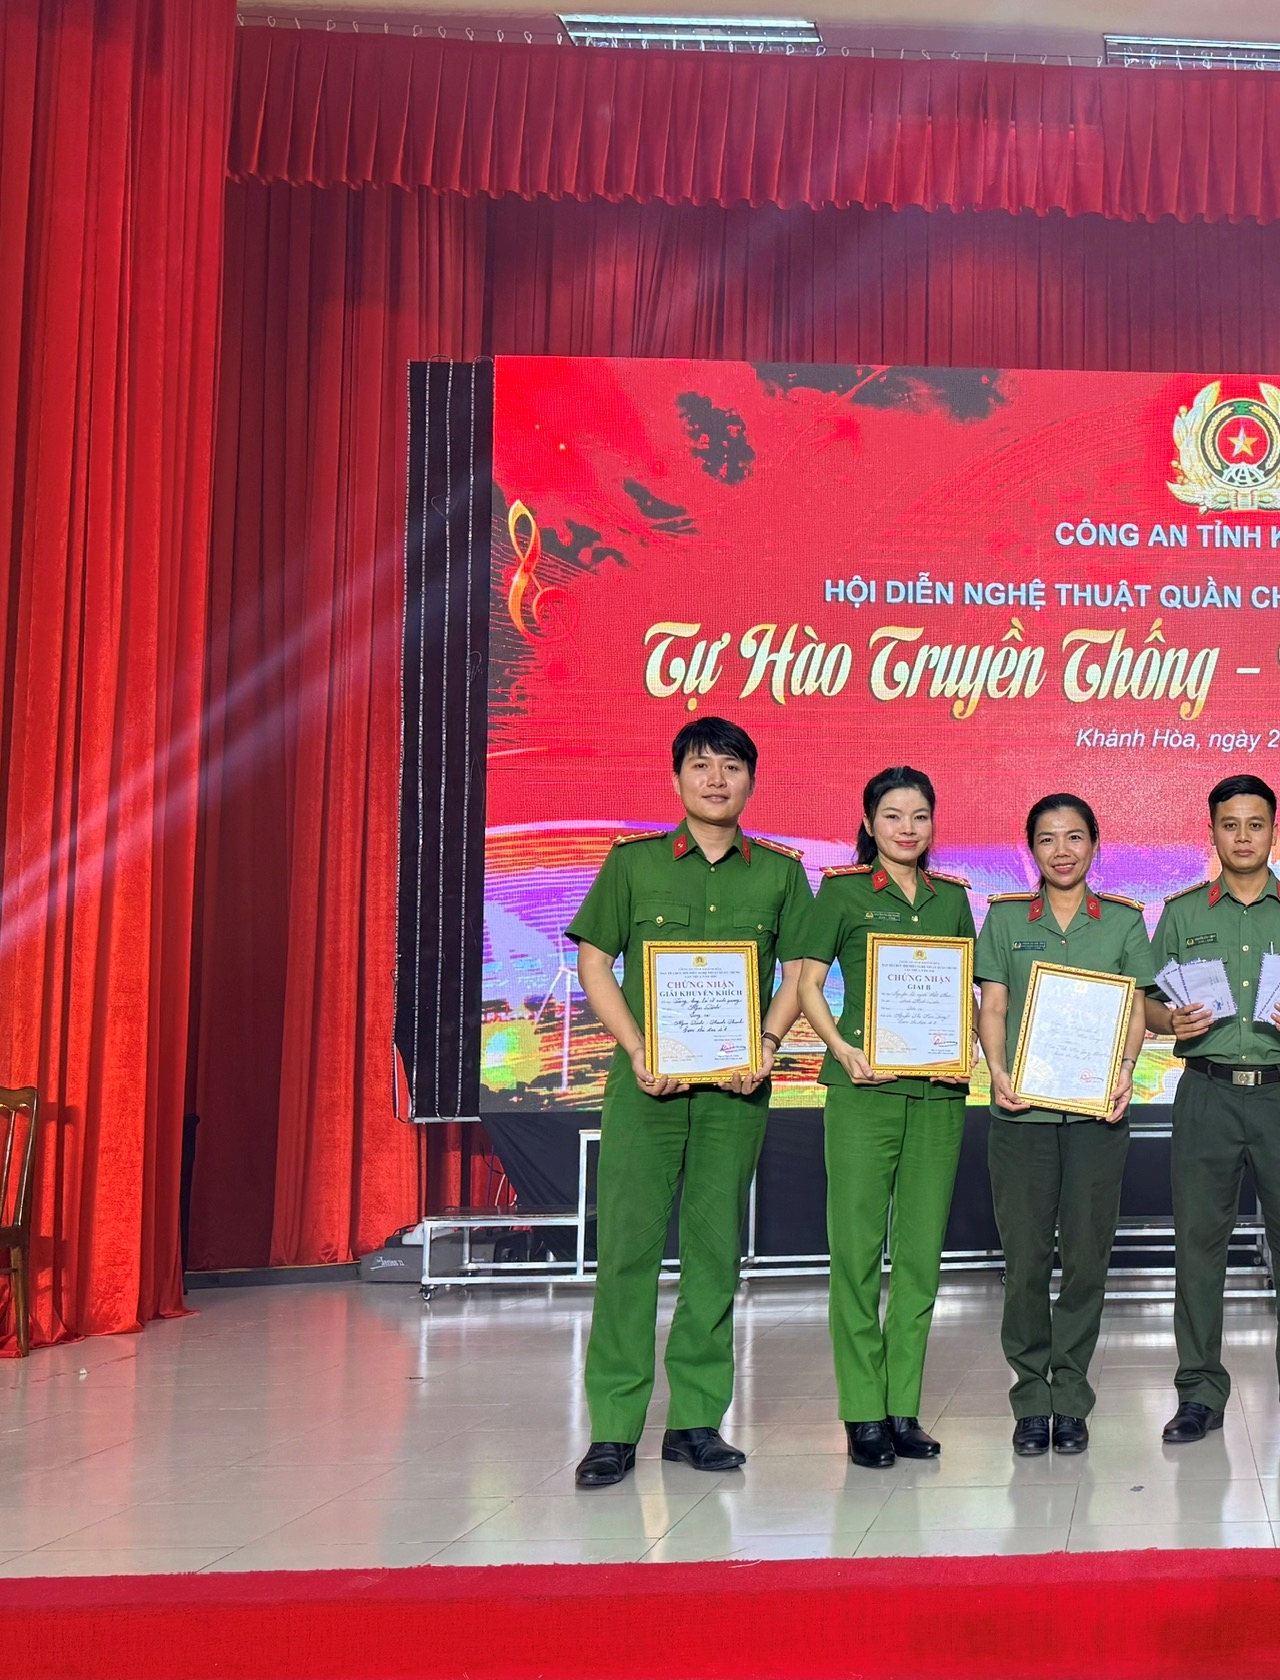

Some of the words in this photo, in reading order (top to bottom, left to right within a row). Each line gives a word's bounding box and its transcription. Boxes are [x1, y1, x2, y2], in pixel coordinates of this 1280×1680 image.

[1056, 518, 1139, 546] CÔNG
[1148, 525, 1187, 547] AN
[1197, 520, 1261, 548] TỈNH
[826, 575, 875, 608] HỘI
[887, 572, 953, 604] DIỄN
[965, 579, 1046, 611] NGHỆ
[1055, 580, 1151, 612] THUẬT
[1160, 576, 1241, 609] QUẦN
[645, 622, 731, 711] Tự
[739, 624, 852, 704] Hào
[869, 617, 1047, 719] Truyền
[1062, 618, 1220, 720] Thống
[1076, 728, 1145, 747] Khánh
[1152, 727, 1200, 753] Hòa,
[1209, 729, 1261, 753] ngày
[667, 980, 704, 989] CHỨNG
[707, 980, 735, 990] NHẬN
[887, 973, 922, 982] CHỨNG
